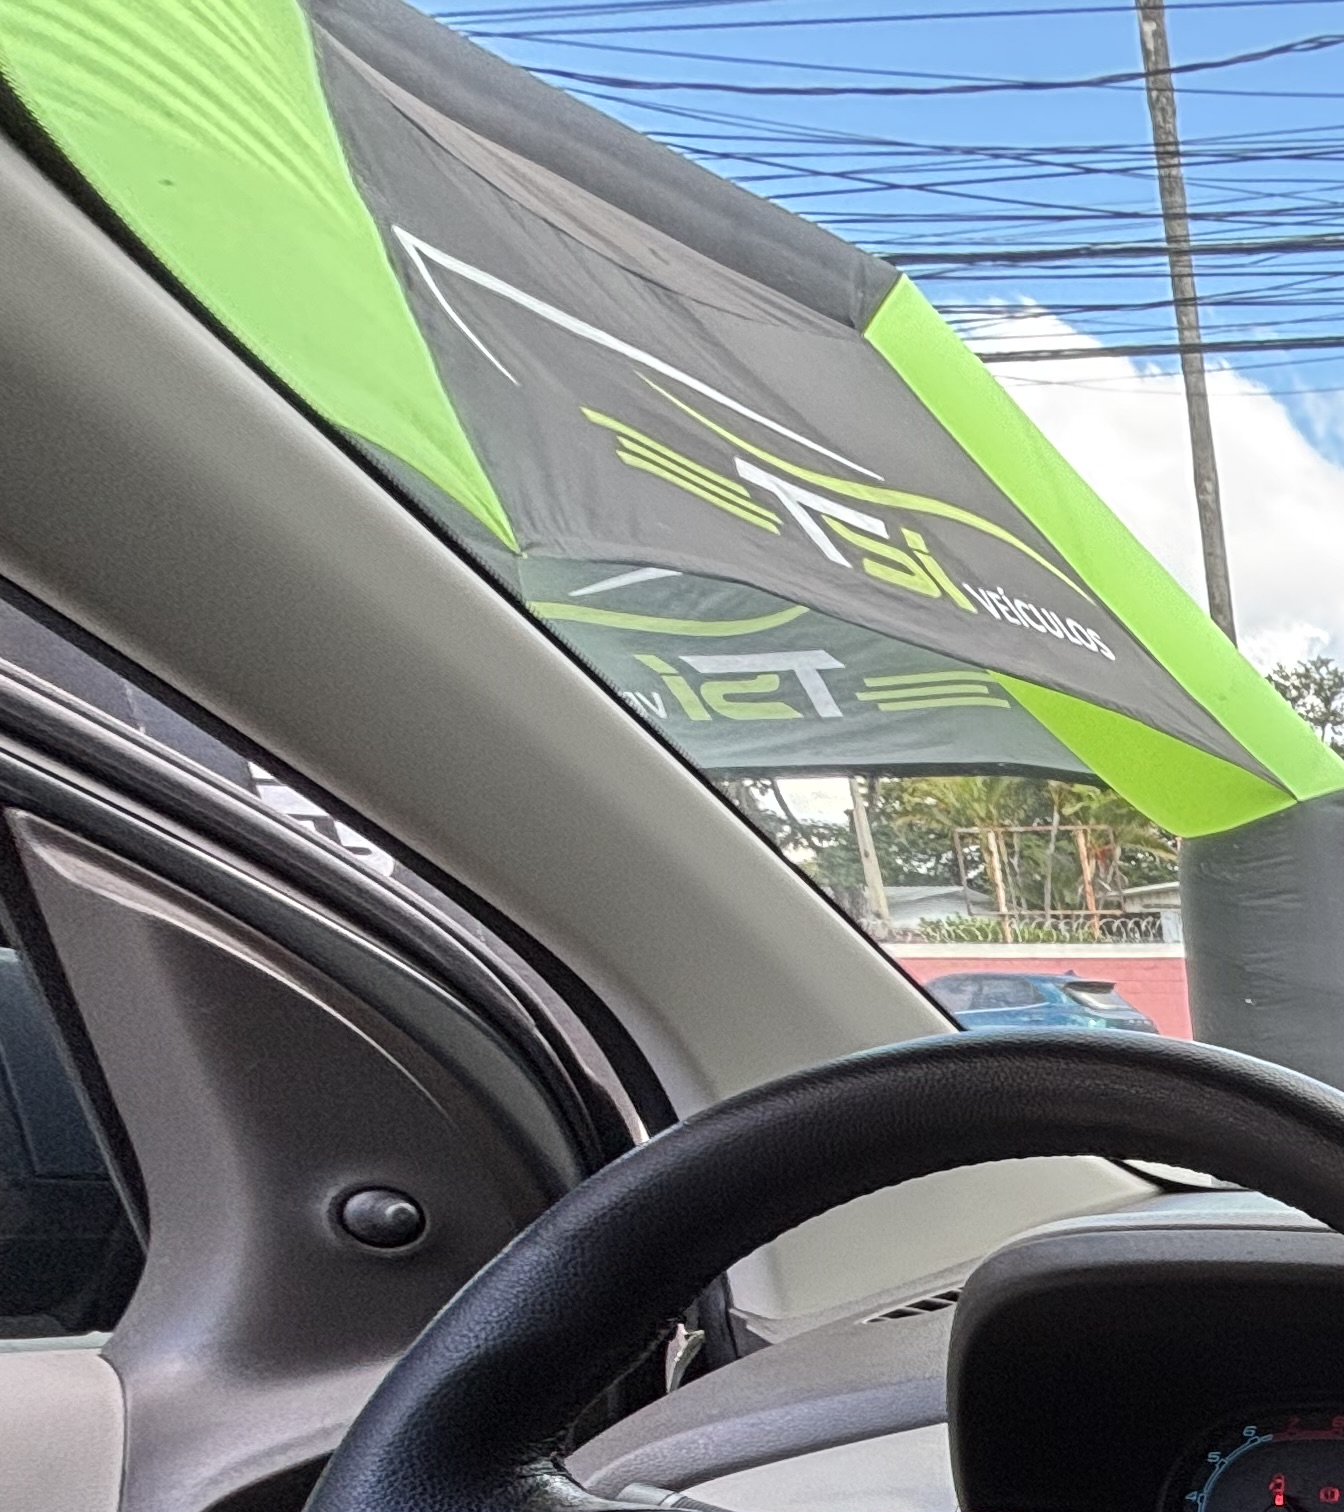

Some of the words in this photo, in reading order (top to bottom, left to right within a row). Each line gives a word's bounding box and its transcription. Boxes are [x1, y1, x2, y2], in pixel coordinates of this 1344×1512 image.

[961, 583, 1117, 662] VEÍCULOS
[1242, 1425, 1257, 1437] 6
[1207, 1452, 1221, 1463] 5
[1185, 1491, 1198, 1501] 4
